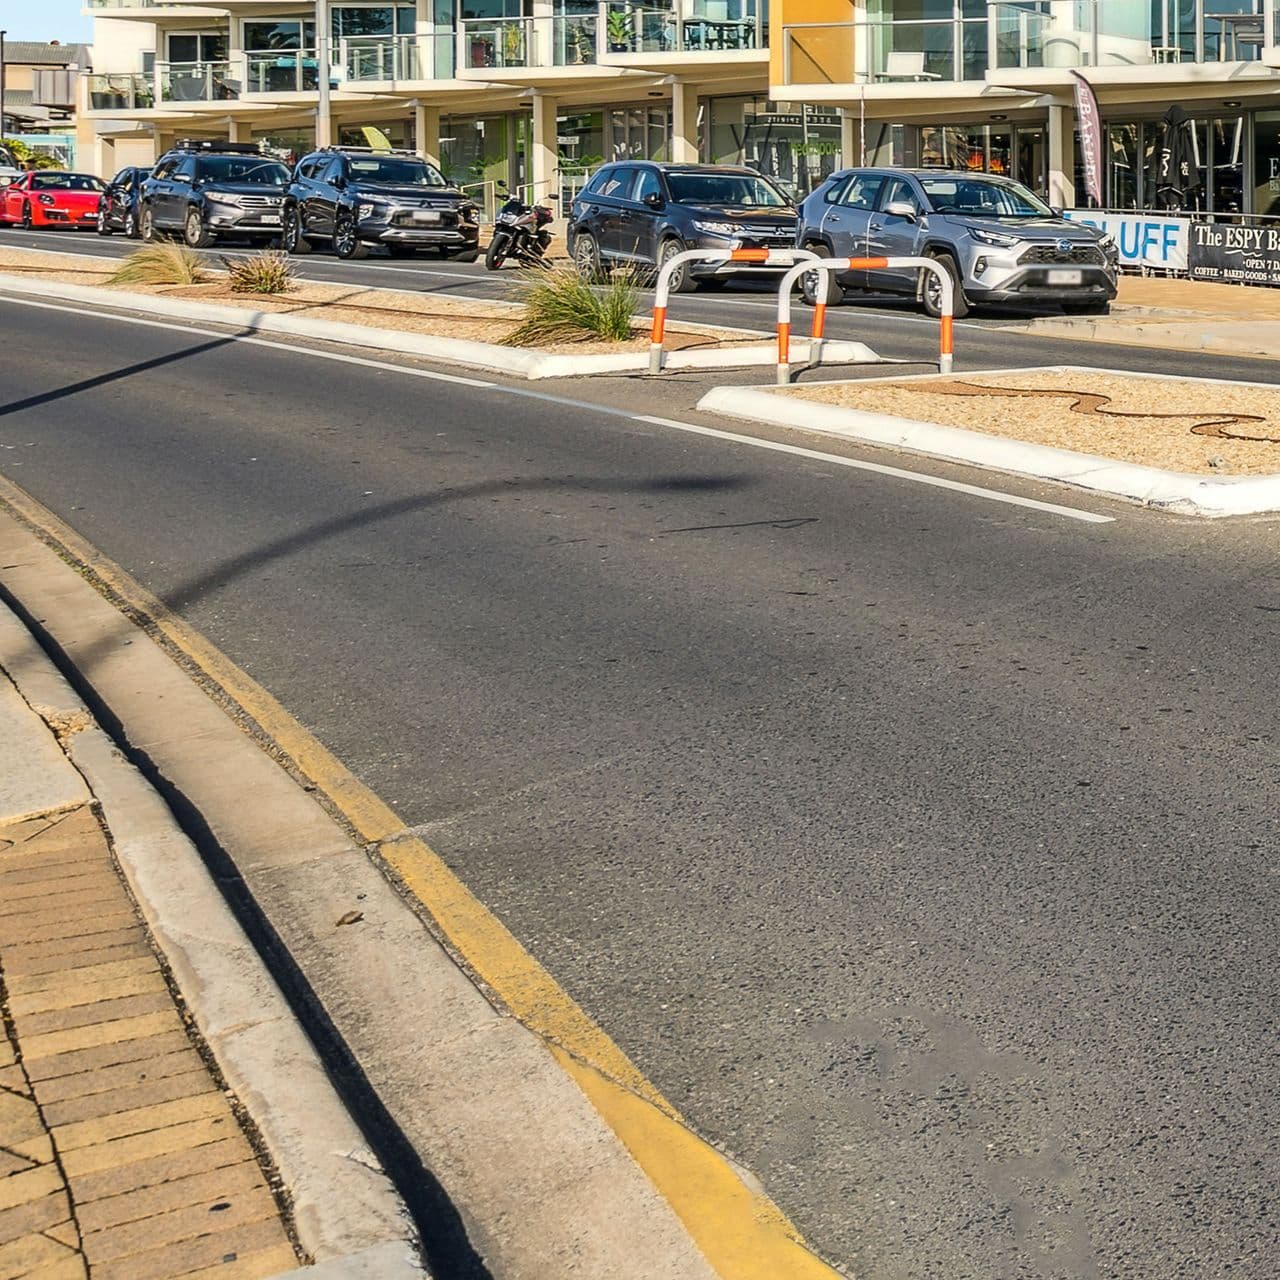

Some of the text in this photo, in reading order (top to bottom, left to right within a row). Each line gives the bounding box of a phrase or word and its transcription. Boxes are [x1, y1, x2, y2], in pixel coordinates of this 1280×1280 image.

[1194, 225, 1223, 247] The
[1225, 227, 1265, 250] ESPY
[1245, 259, 1266, 270] OPEN
[1267, 261, 1272, 270] 7
[1194, 266, 1219, 277] COFFEE
[1223, 268, 1245, 279] BAKED
[1245, 271, 1268, 282] GOODS
